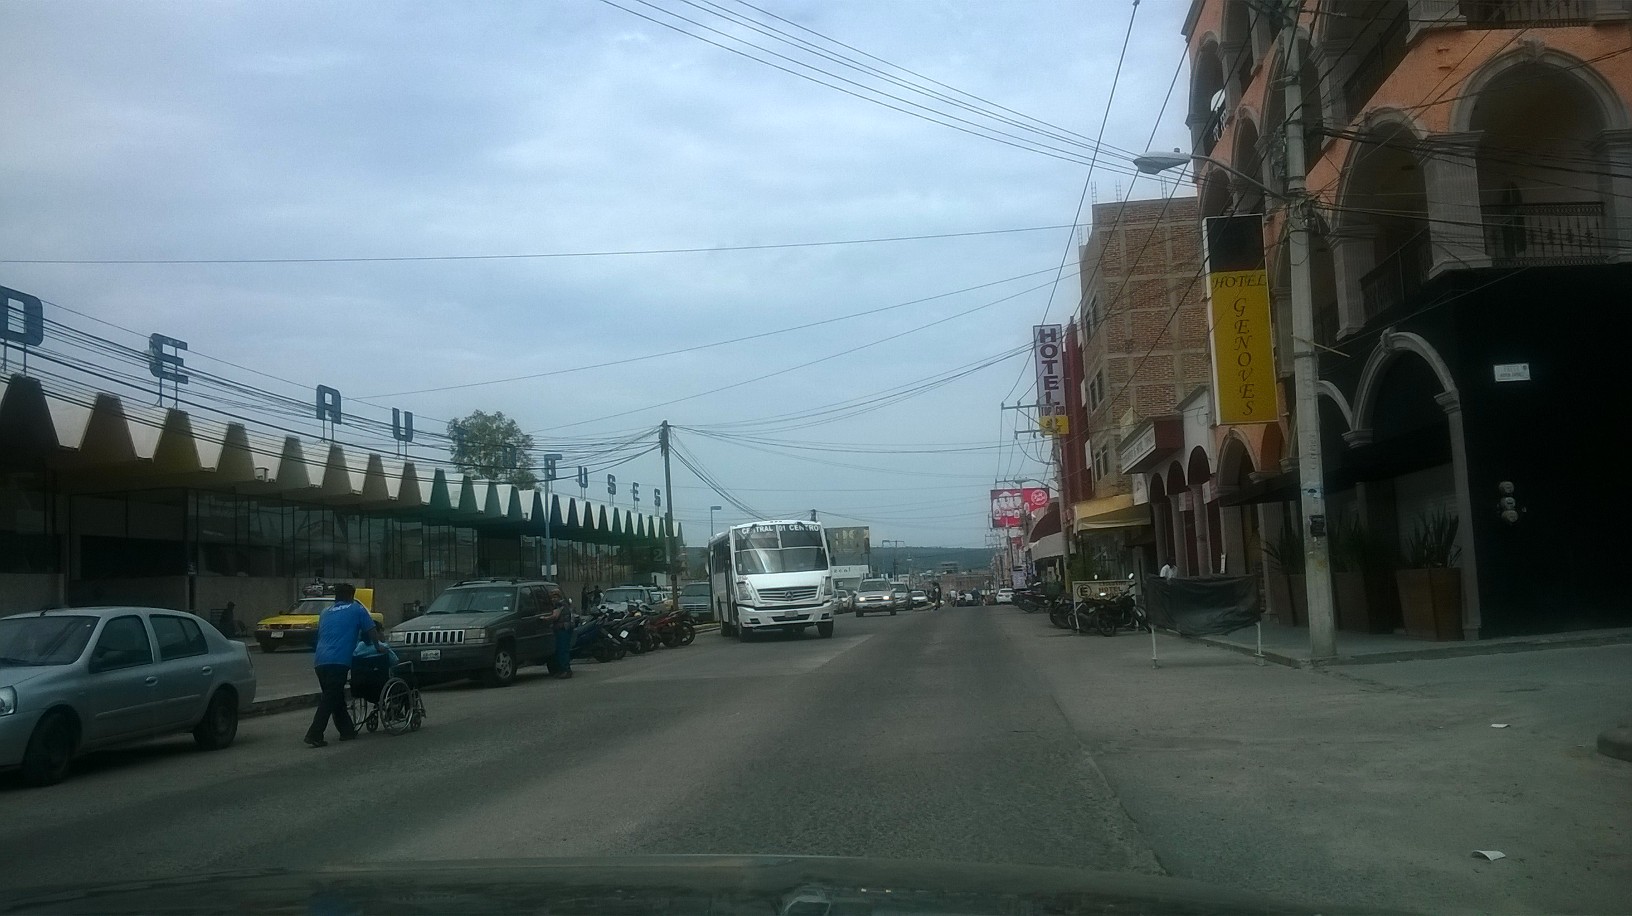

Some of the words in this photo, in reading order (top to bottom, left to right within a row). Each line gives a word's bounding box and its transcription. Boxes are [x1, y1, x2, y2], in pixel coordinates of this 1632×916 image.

[1213, 274, 1267, 288] HOTEL
[1039, 328, 1060, 405] HOTEL
[1233, 298, 1255, 416] GENOVES
